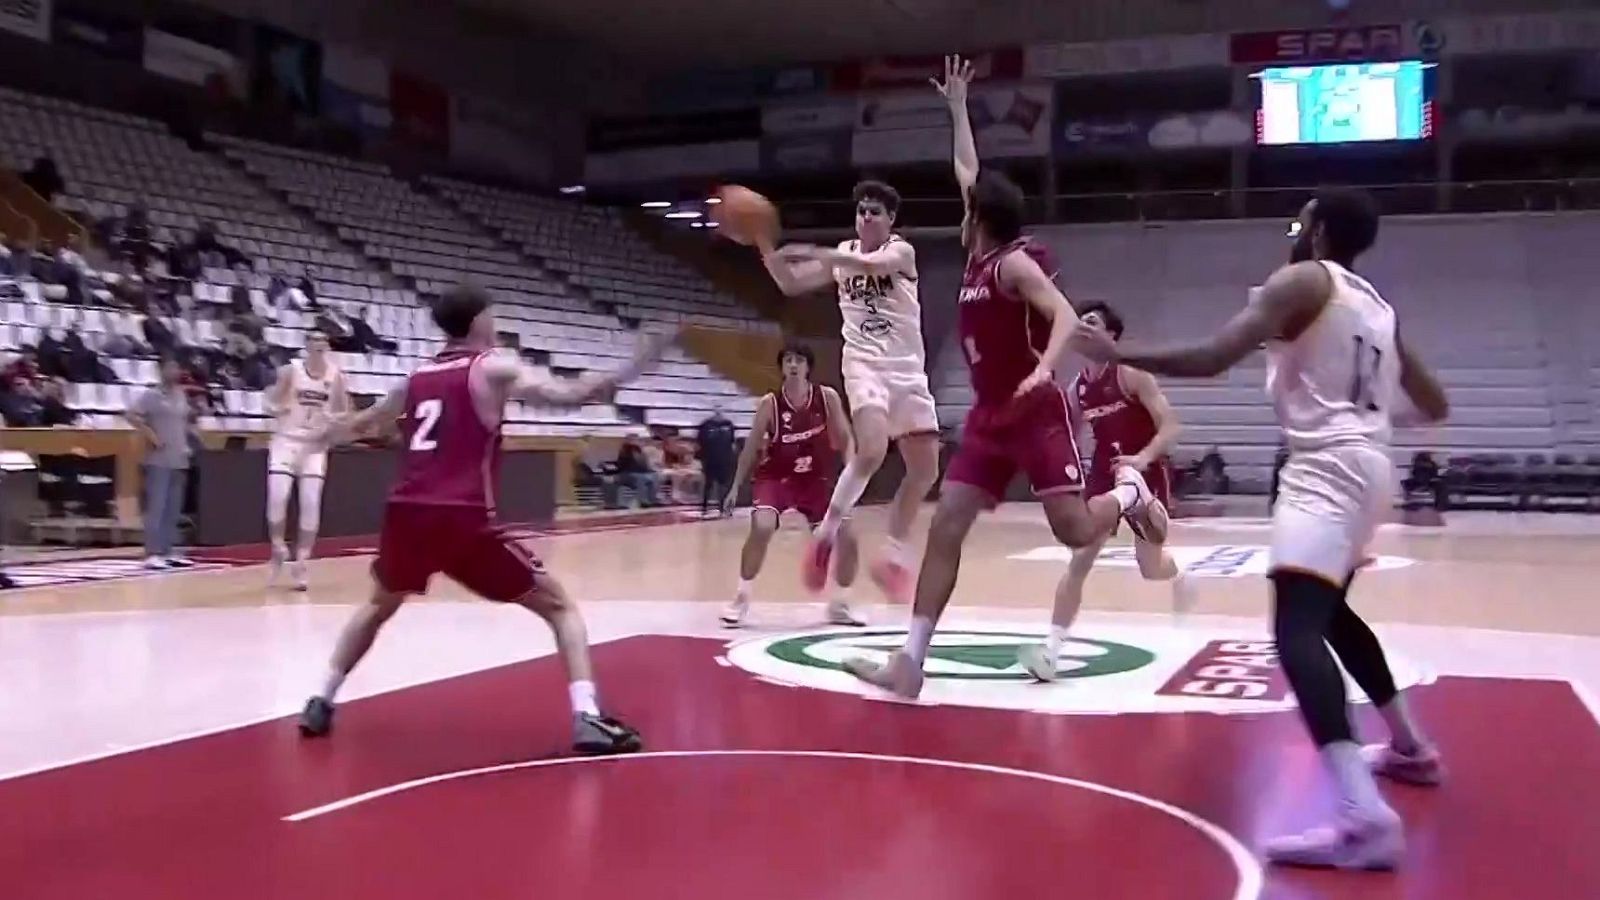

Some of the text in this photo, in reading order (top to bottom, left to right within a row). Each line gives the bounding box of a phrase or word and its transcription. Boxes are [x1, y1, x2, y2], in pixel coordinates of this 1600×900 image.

[1276, 25, 1399, 56] SPAR
[864, 298, 878, 315] 5
[410, 399, 443, 451] 2
[1180, 641, 1281, 698] SPAR
